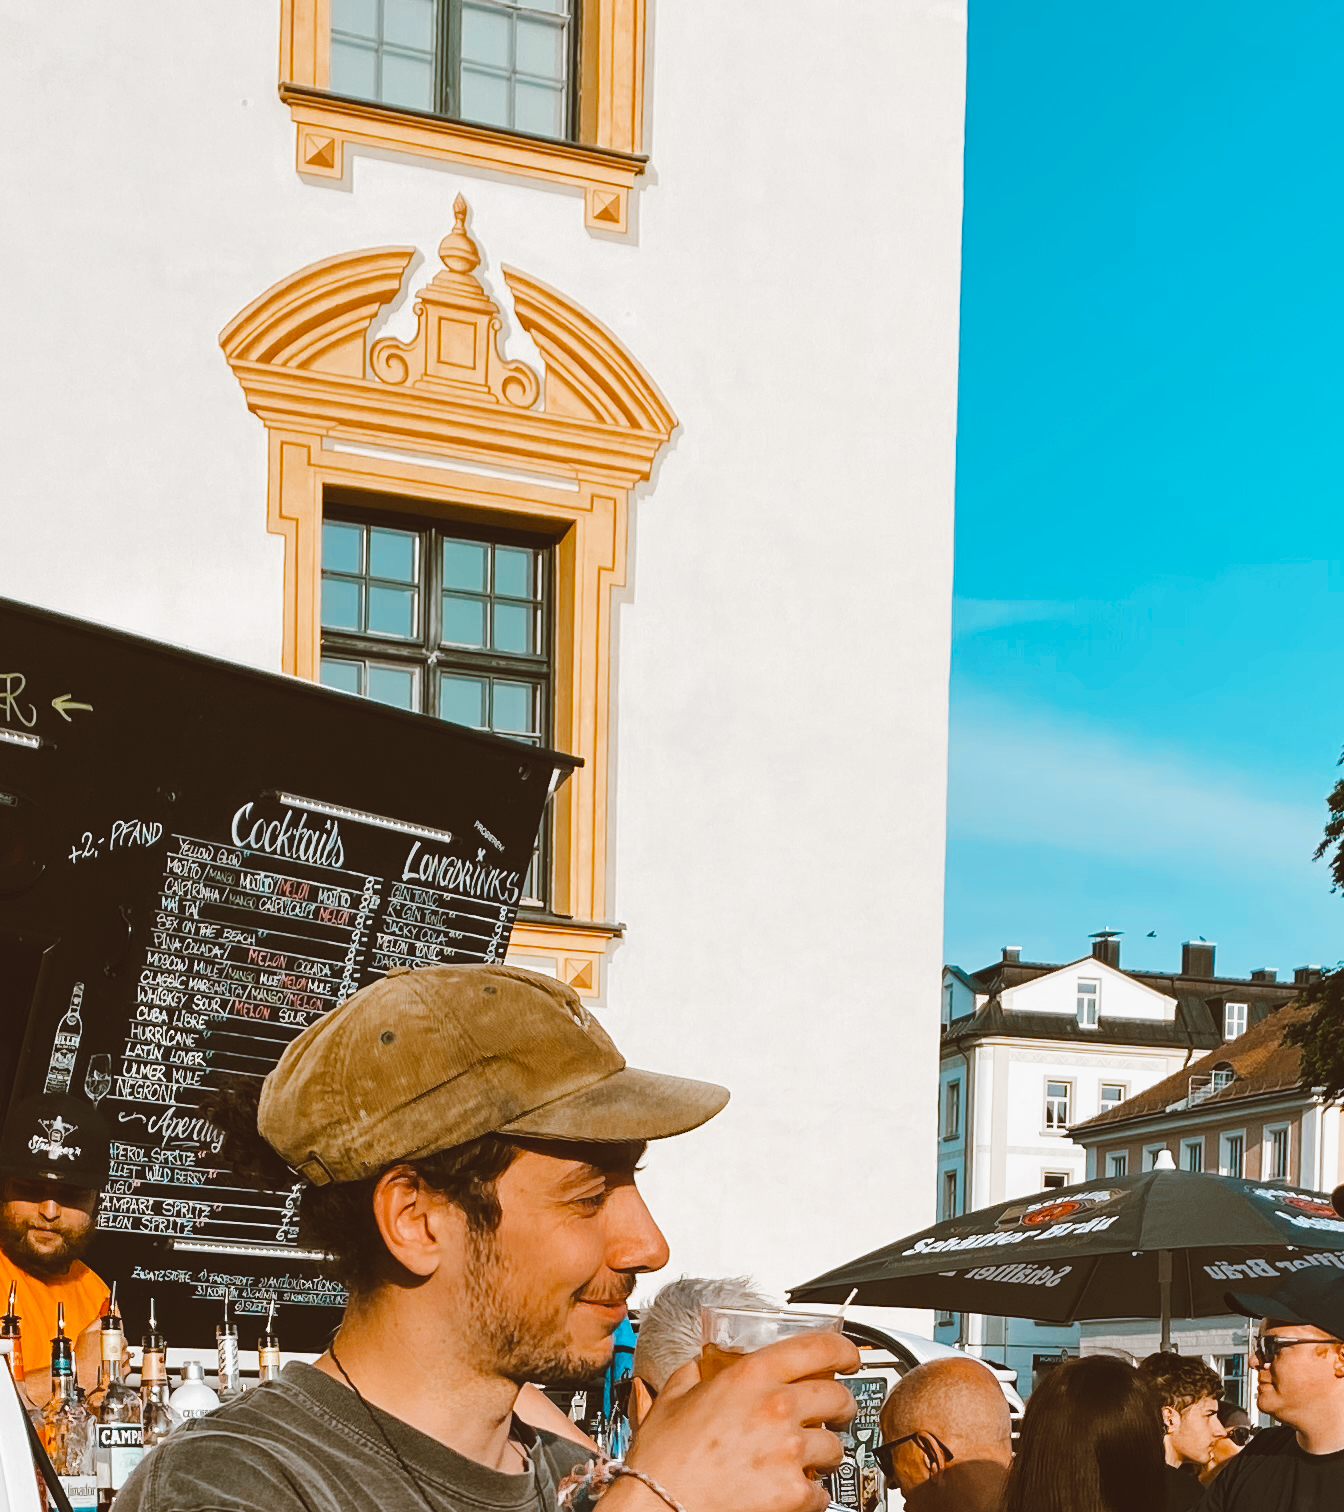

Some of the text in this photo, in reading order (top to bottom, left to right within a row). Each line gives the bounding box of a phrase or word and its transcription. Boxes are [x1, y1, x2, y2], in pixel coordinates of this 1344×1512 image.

[110, 819, 164, 851] PFAND
[231, 801, 345, 868] Cocktails
[179, 837, 214, 861] YELLOW
[166, 857, 202, 879] MOJITO
[161, 895, 179, 914] MAI
[390, 884, 411, 902] GIN
[413, 889, 439, 907] TONIC
[156, 913, 179, 933] SEX
[182, 921, 197, 936] ON
[198, 923, 221, 939] THE
[222, 929, 256, 946] BEACH
[402, 905, 422, 922] GIN
[424, 909, 448, 928] TONIC
[383, 918, 419, 940] JACKY
[420, 928, 449, 947] COLA
[182, 938, 224, 959] COLADA
[247, 946, 288, 970] MELON
[376, 932, 443, 961] MELON TONIC
[193, 959, 220, 979] MULE
[307, 978, 332, 995] MULE
[140, 970, 188, 990] CLASSIC
[288, 993, 325, 1011] MELON
[136, 1005, 209, 1030] CUBA LIBRE
[137, 986, 189, 1009] WHISKEY
[192, 994, 226, 1016] SOUR
[233, 1000, 271, 1021] MELON
[278, 1008, 309, 1026] SOUR
[130, 1022, 200, 1048] HURRICANE
[124, 1042, 207, 1067] LATIN LOVER
[122, 1060, 205, 1086] ULMER MULE
[116, 1078, 177, 1104] NEGRONI
[150, 1147, 197, 1167] SPRITZ
[109, 1160, 142, 1179] ILLET
[145, 1166, 171, 1180] WILD
[174, 1169, 208, 1185] BERRY
[96, 1194, 155, 1216] AMPARI
[162, 1199, 212, 1222] SPRITZ
[139, 1217, 194, 1237] SPRITZ
